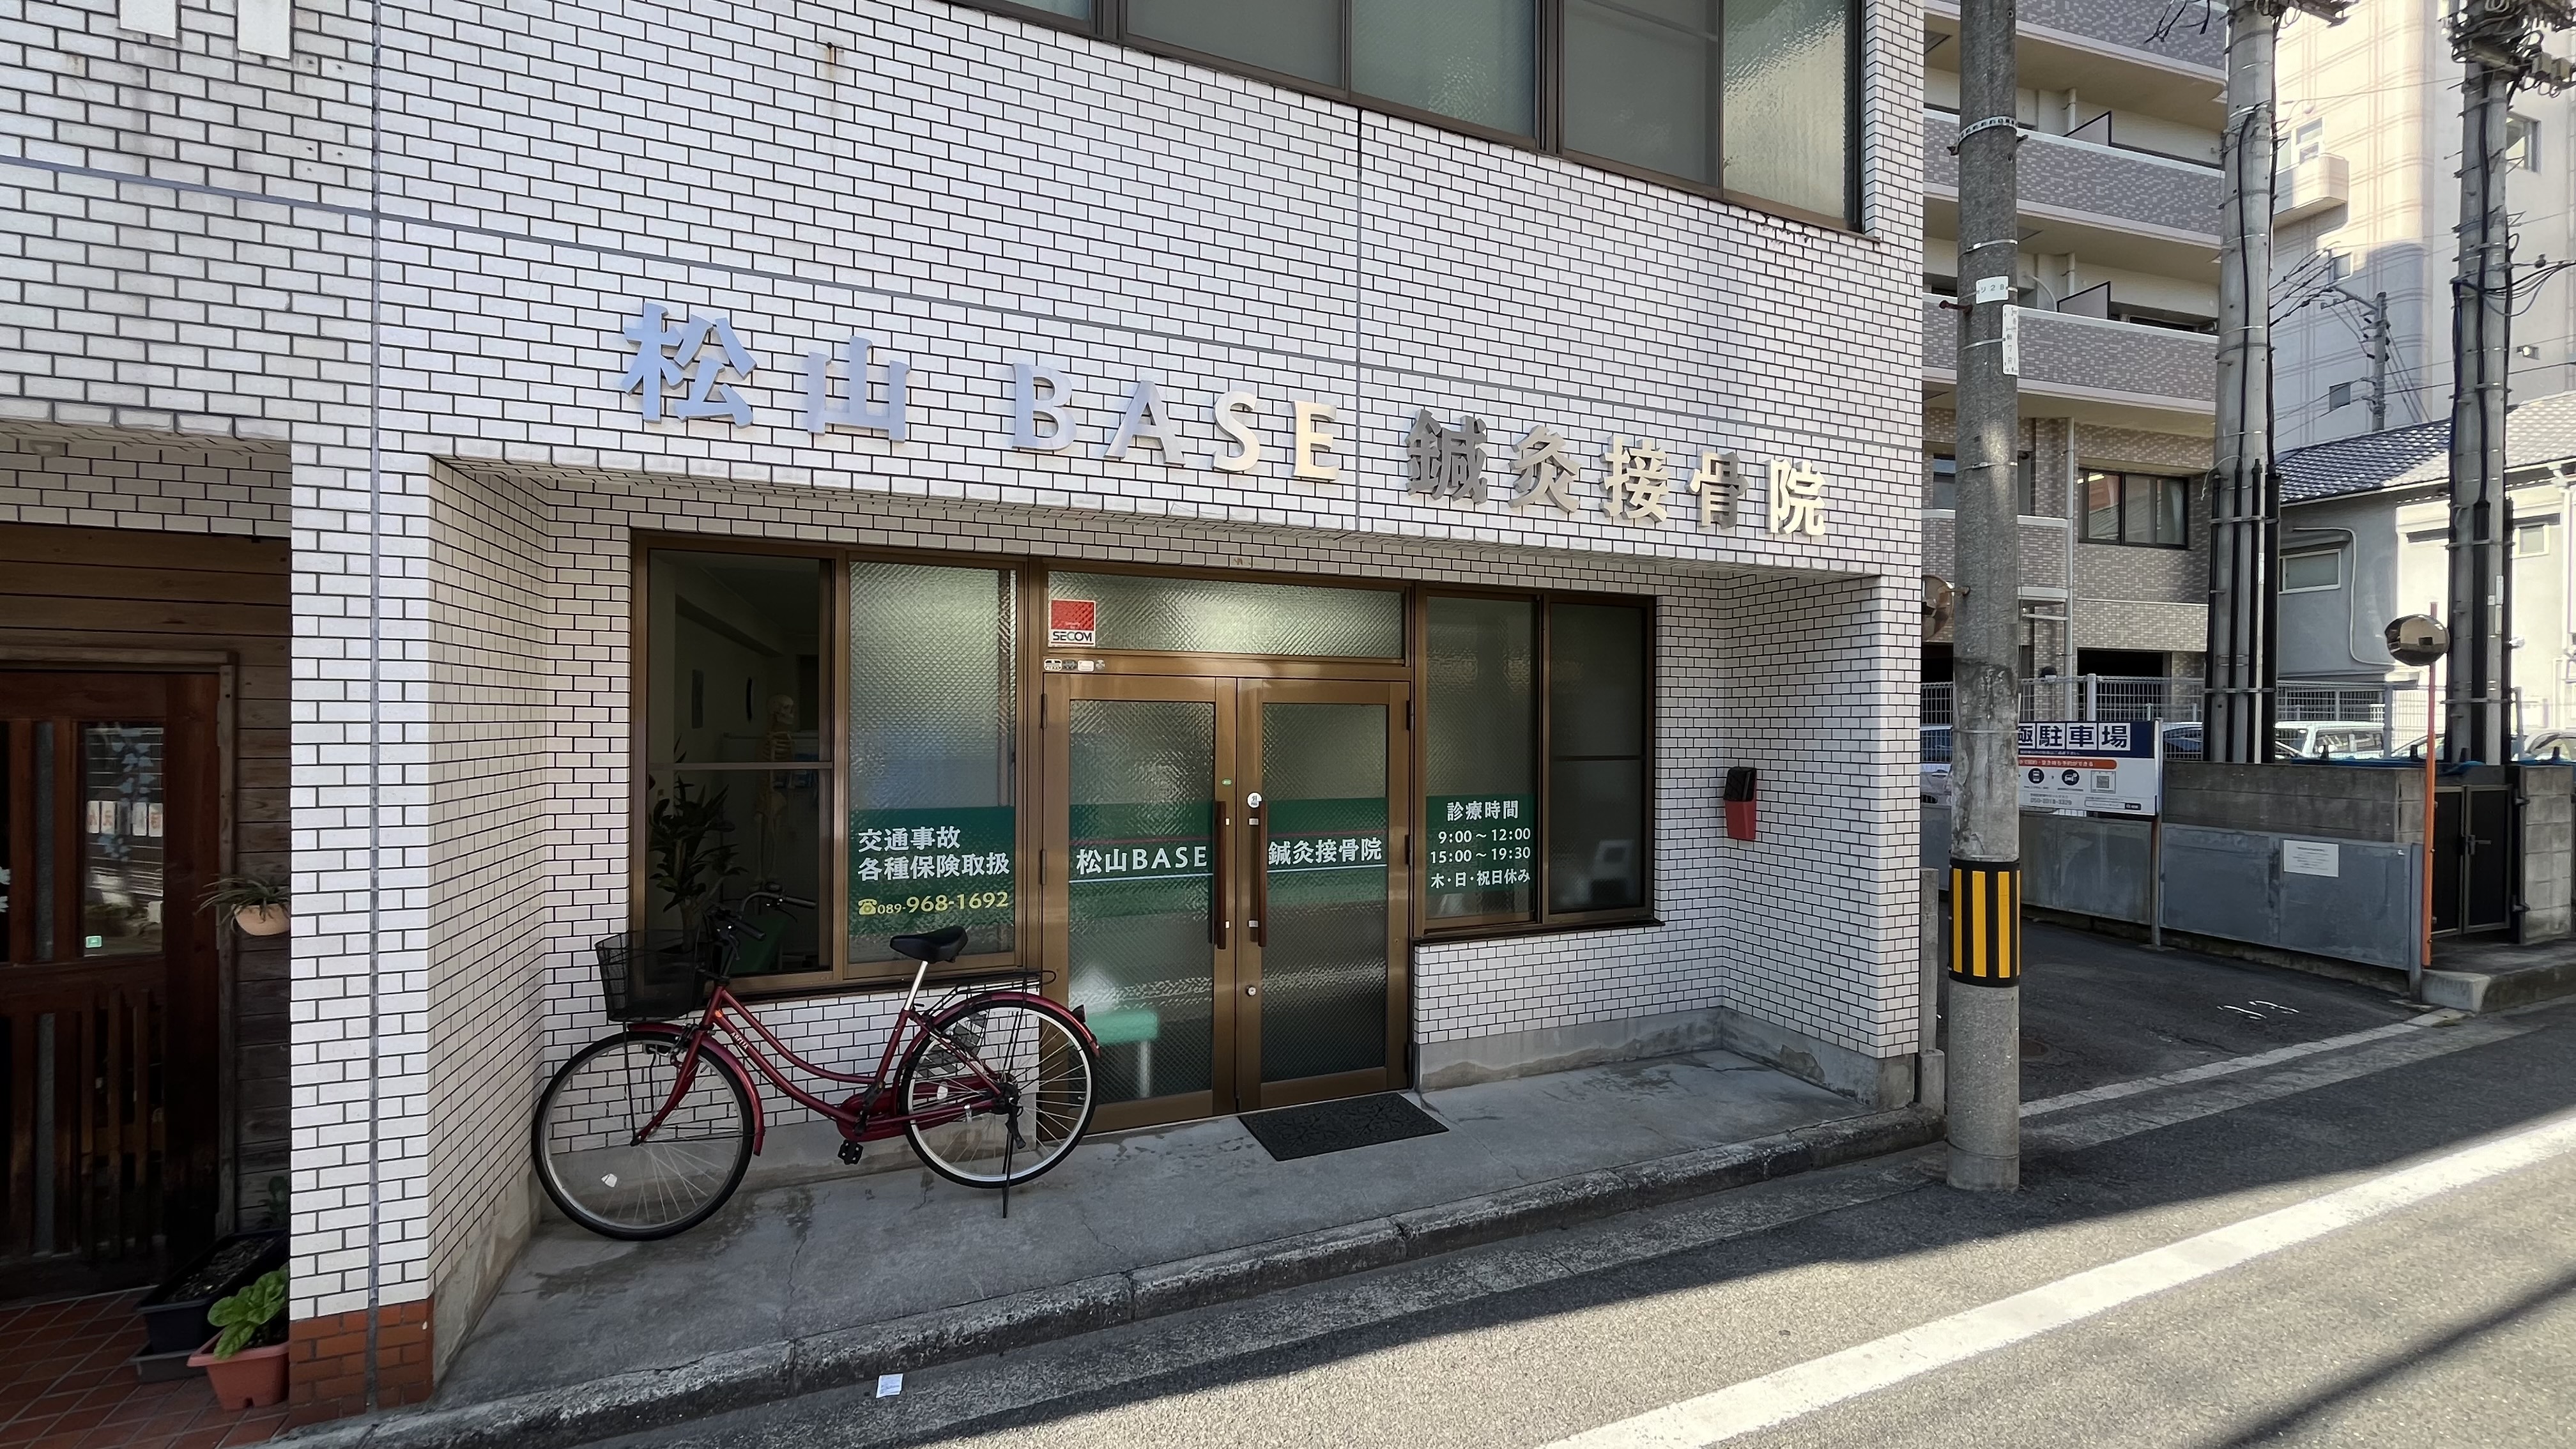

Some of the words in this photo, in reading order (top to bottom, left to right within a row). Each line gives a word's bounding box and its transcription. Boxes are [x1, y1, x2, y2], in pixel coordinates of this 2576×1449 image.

[622, 302, 910, 445] 松山
[1012, 362, 1338, 481] BASE
[1404, 408, 1827, 537] 鍼灸接骨院
[1053, 631, 1092, 641] SECOM
[1446, 800, 1519, 822] 診療時間
[858, 825, 961, 852] 交通事故
[857, 852, 1011, 881] 各種保険取扱
[1076, 846, 1208, 875] 松山BASE
[1268, 837, 1382, 866] 鍼灸接骨院
[1430, 868, 1531, 889] 木・日・祝日休み
[877, 891, 1009, 914] 089-968-1692
